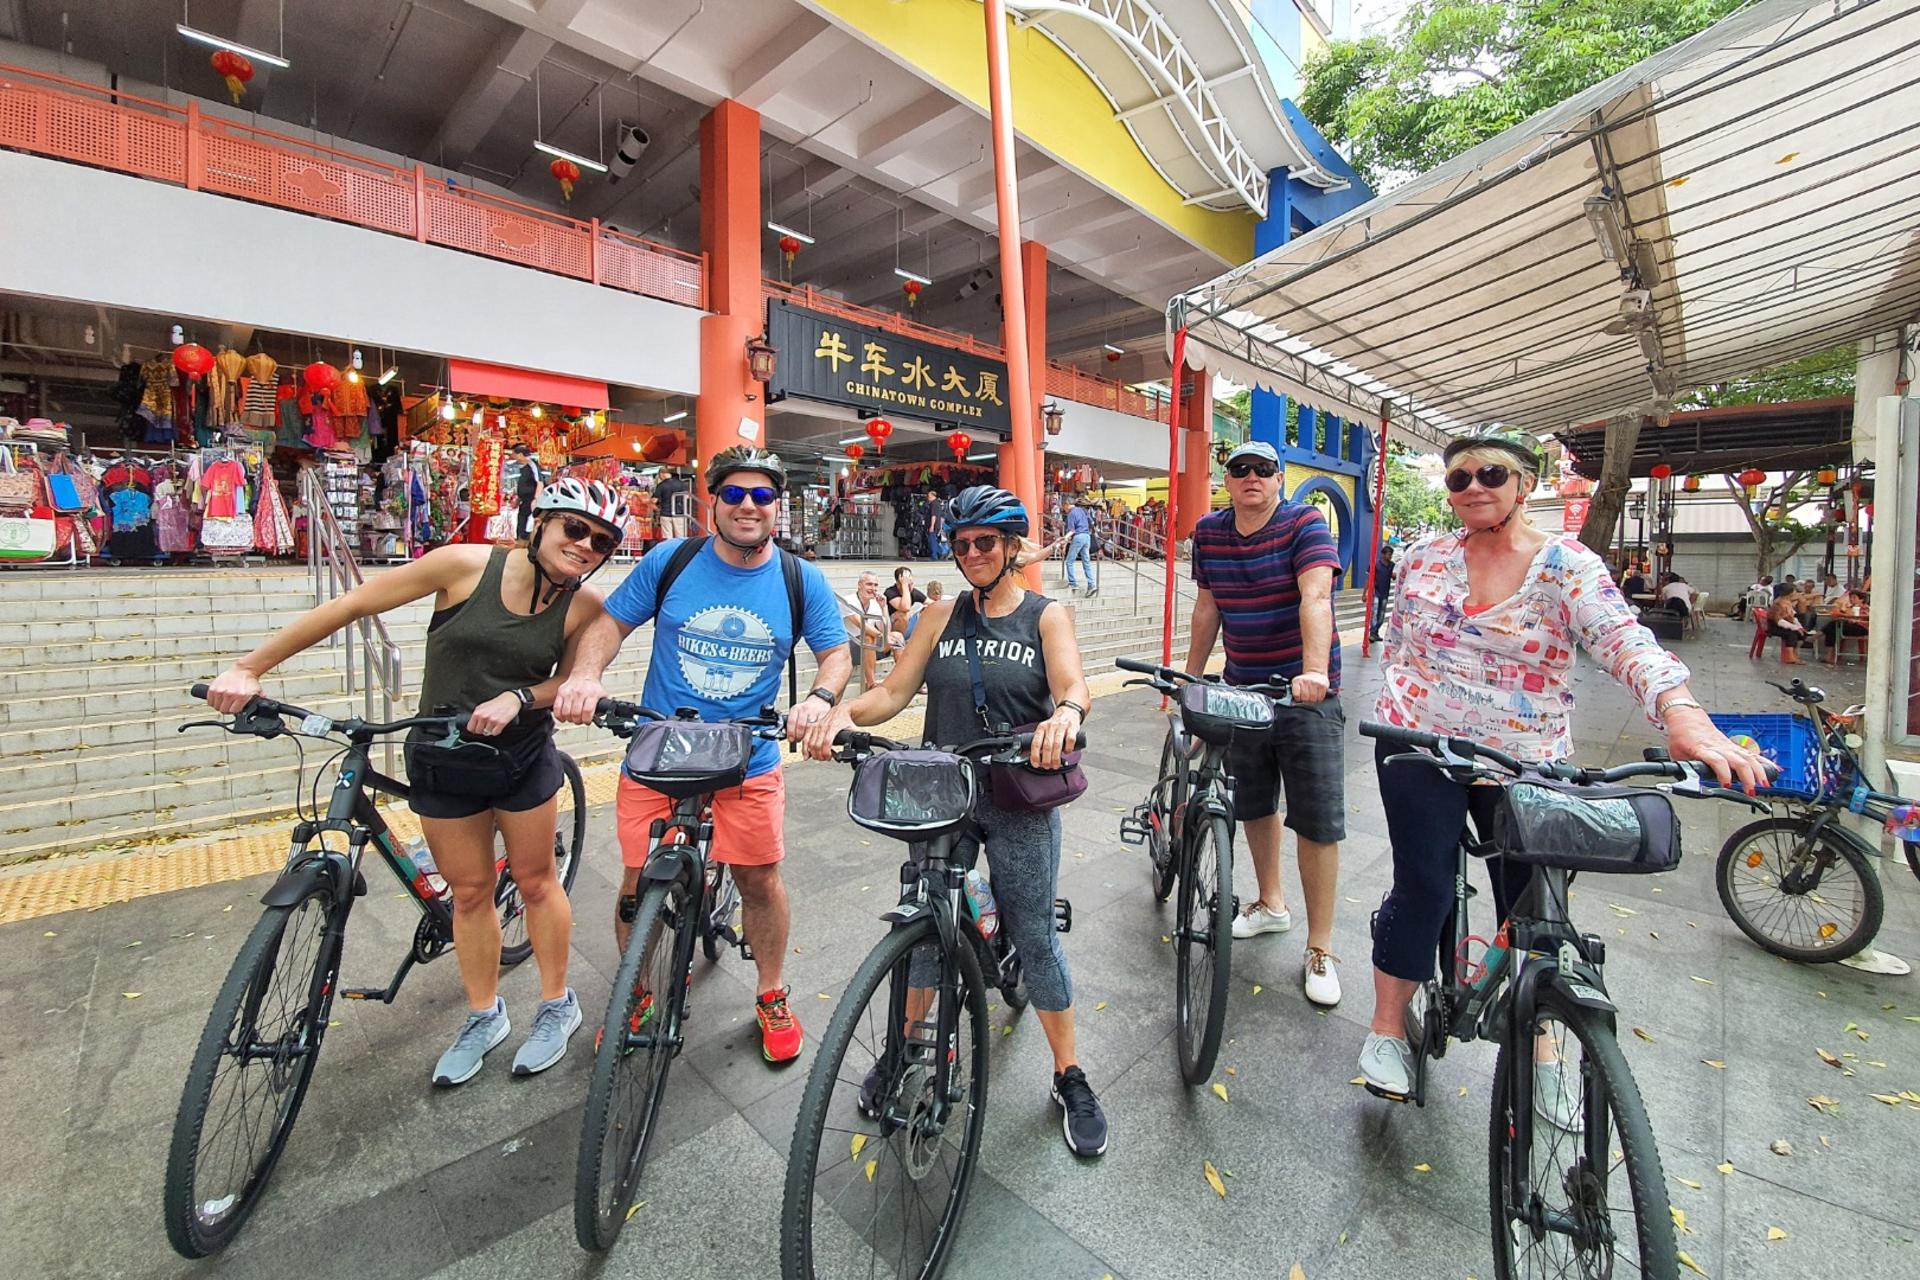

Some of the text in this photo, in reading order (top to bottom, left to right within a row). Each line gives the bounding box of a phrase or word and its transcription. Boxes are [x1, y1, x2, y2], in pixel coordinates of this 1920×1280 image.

[815, 330, 1003, 406] 牛车水大厦
[846, 381, 983, 417] CHINATOWN COMPLEX
[678, 634, 719, 657] BIKES
[728, 646, 774, 663] BEERS
